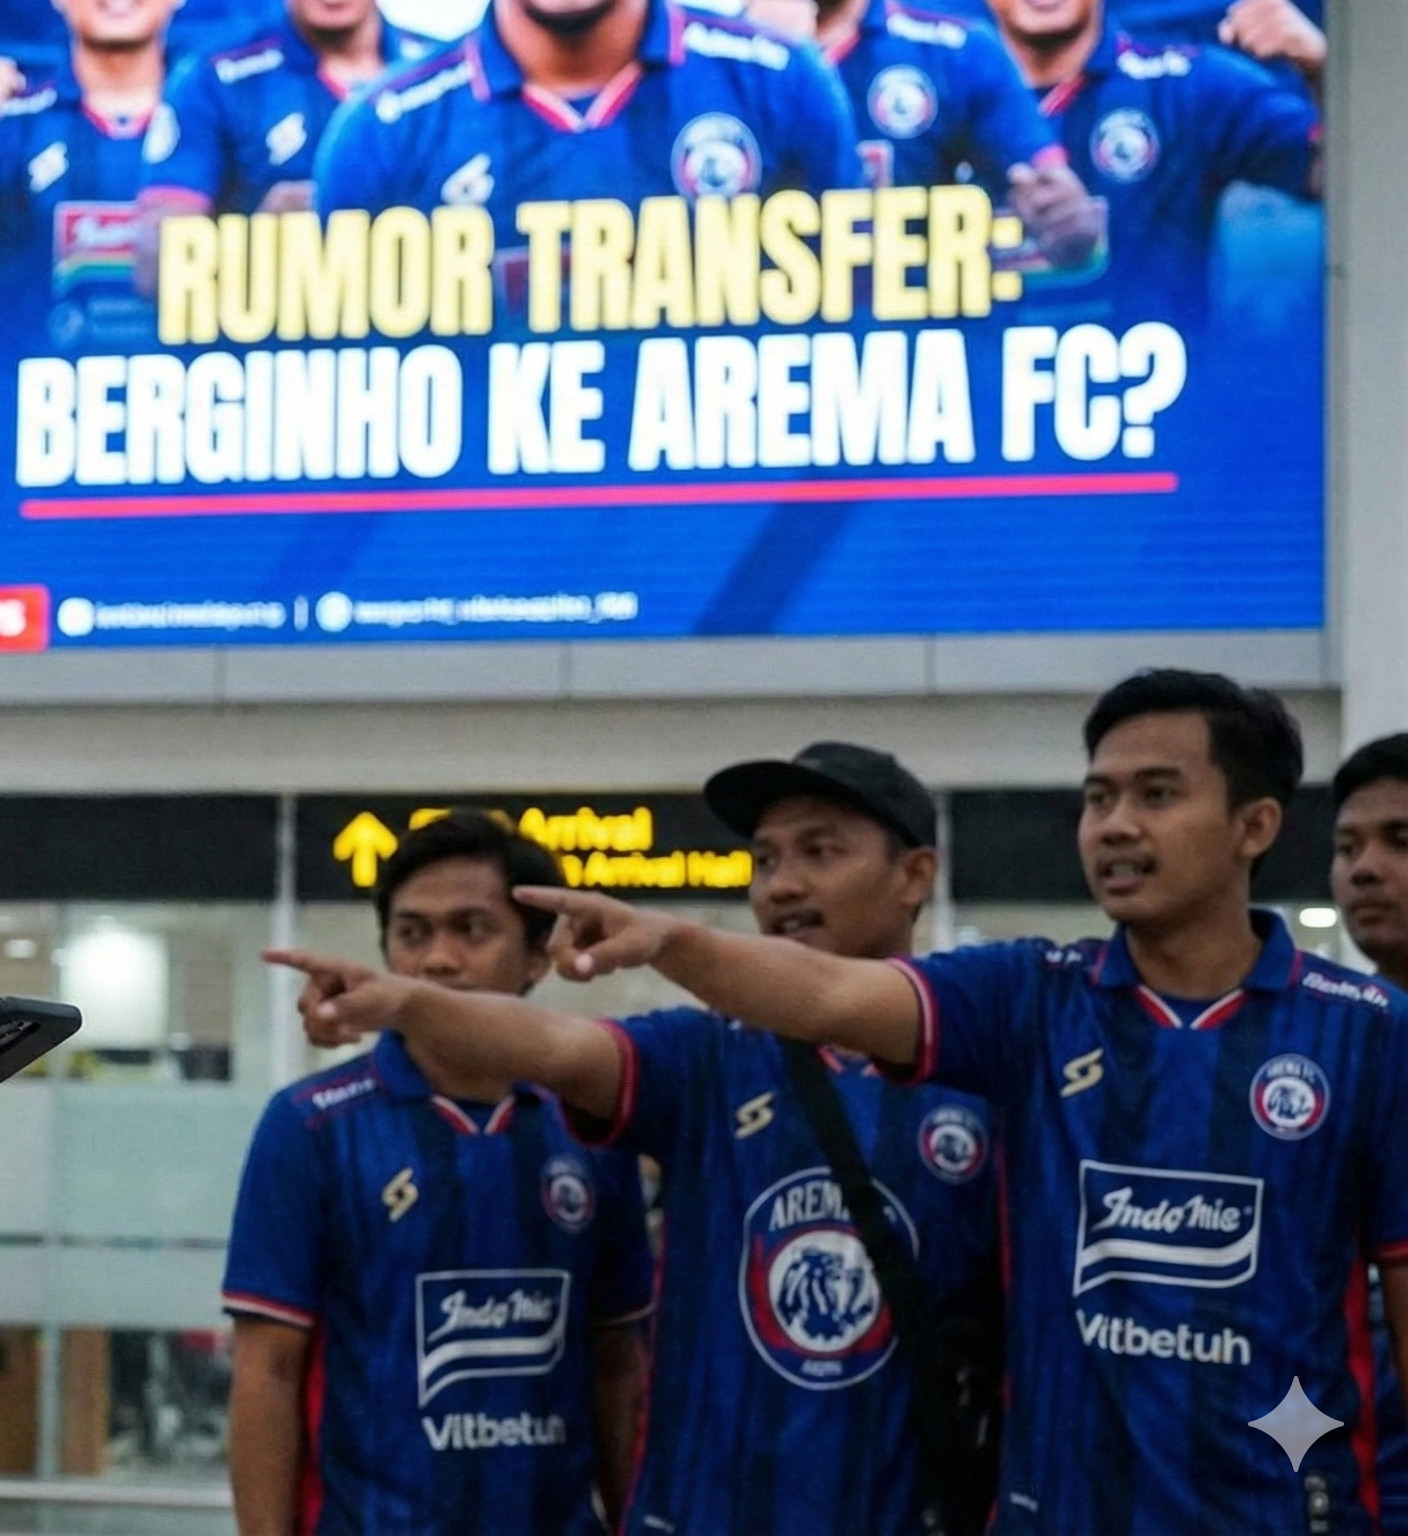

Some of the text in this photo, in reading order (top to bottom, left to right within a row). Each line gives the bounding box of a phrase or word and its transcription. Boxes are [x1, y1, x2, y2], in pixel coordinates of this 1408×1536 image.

[158, 185, 1022, 347] RUMOR TRANSFER:
[17, 322, 1187, 486] BERGINHO KE AREMA FC?
[768, 1179, 850, 1232] AREM
[1074, 1308, 1252, 1366] Vitbetuh
